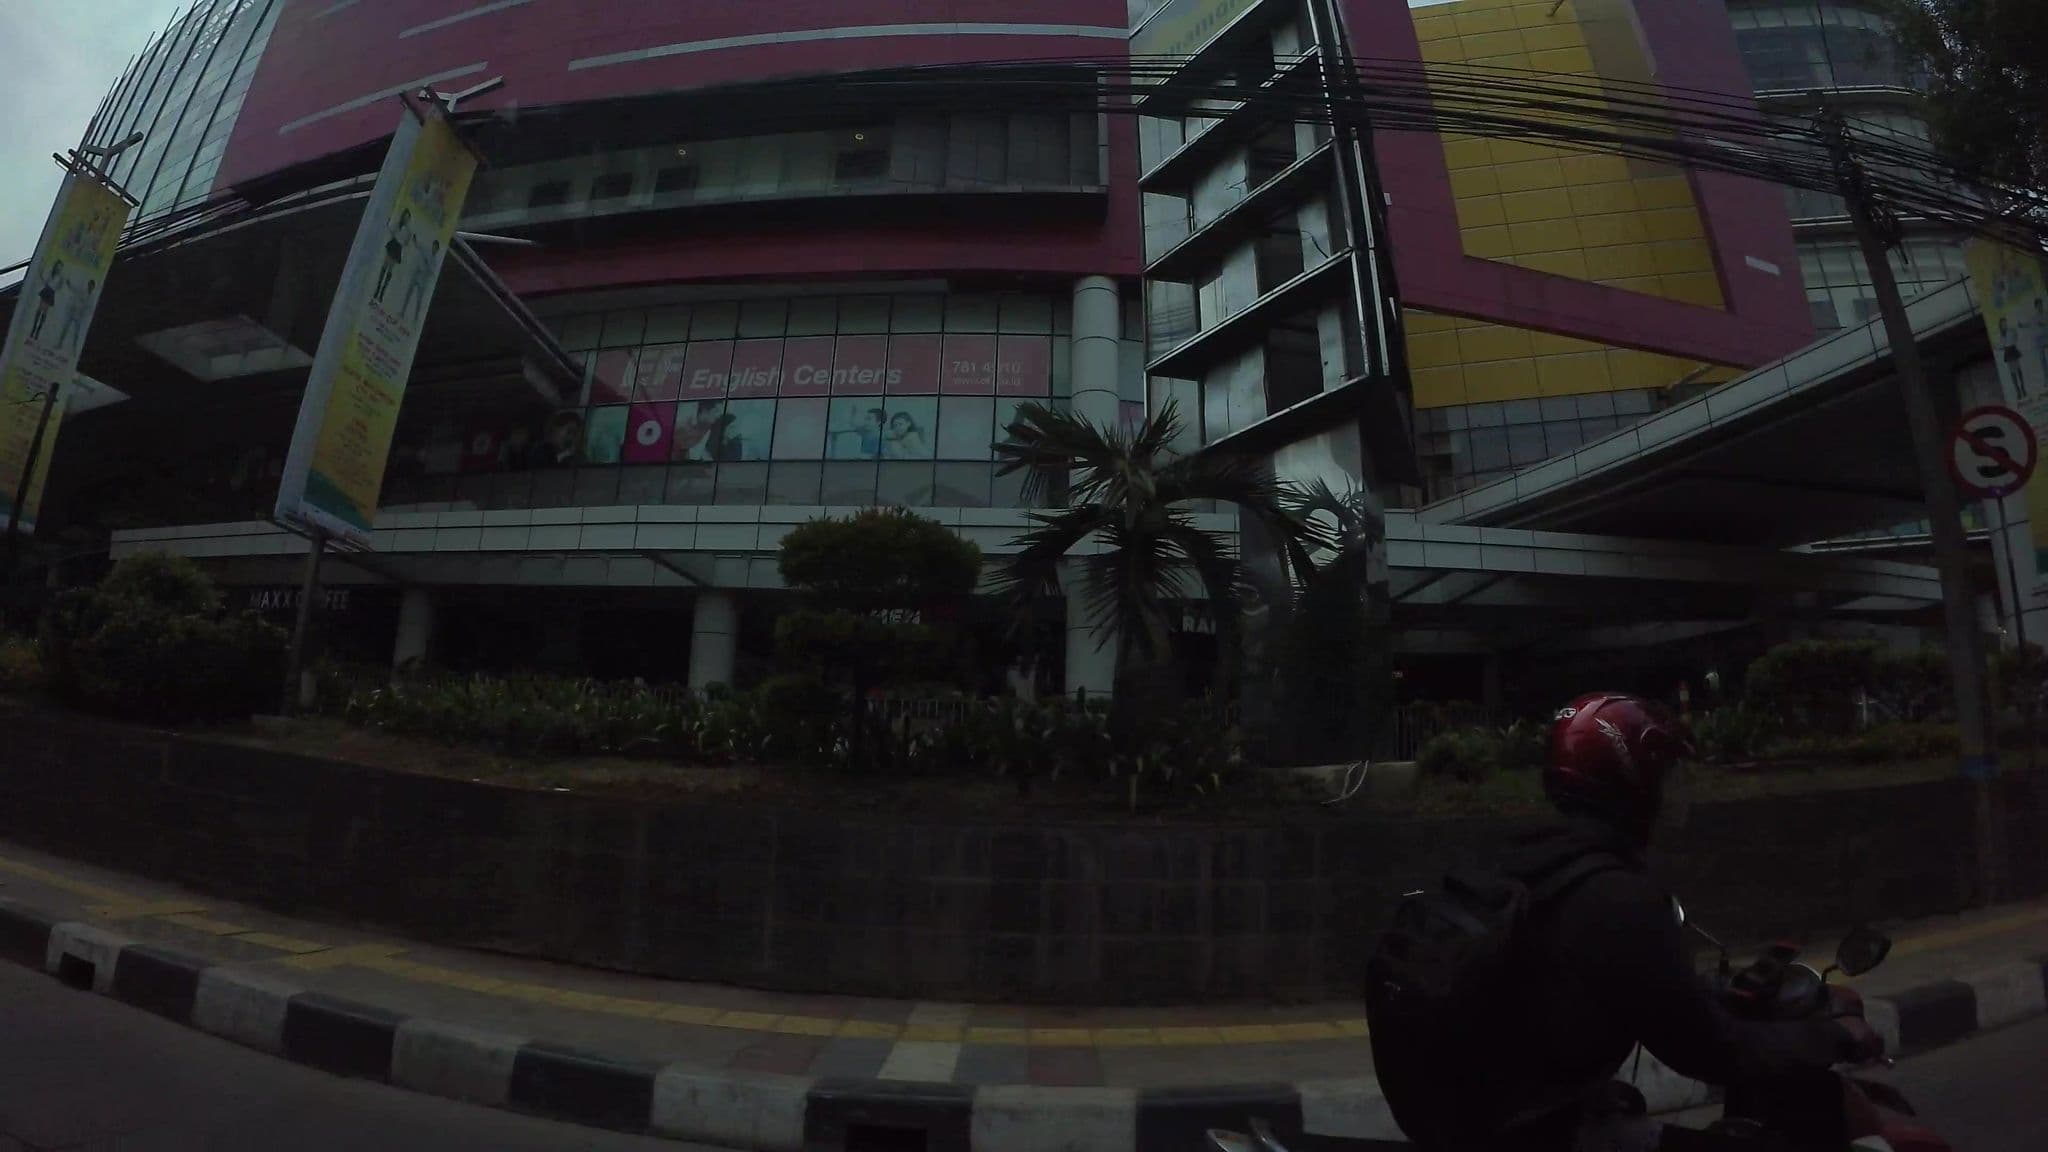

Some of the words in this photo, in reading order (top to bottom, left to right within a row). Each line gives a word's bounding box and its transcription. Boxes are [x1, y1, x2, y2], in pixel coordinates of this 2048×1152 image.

[952, 360, 976, 373] 781
[689, 366, 785, 391] English
[793, 364, 903, 385] Centers
